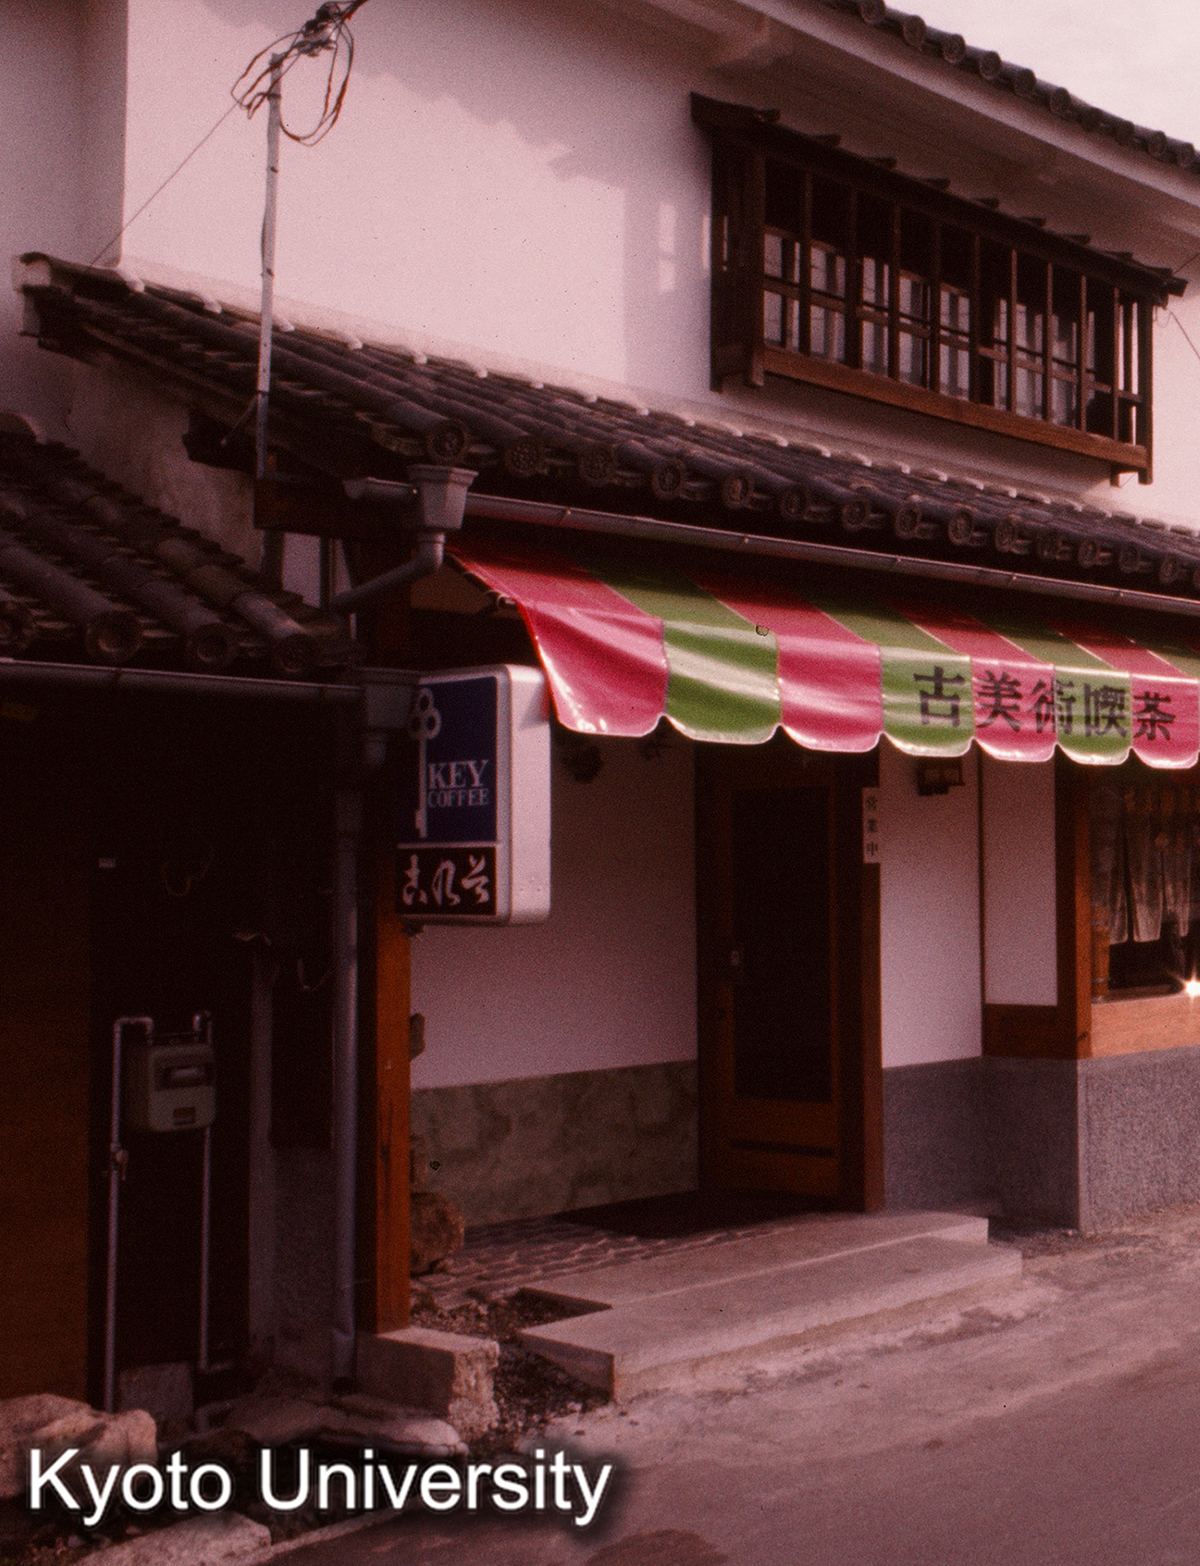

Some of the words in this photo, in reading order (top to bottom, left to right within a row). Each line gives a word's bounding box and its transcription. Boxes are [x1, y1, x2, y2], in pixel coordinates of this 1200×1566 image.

[914, 666, 1176, 740] 古美術喫茶
[428, 759, 489, 789] KEY
[428, 788, 489, 808] COFFEE
